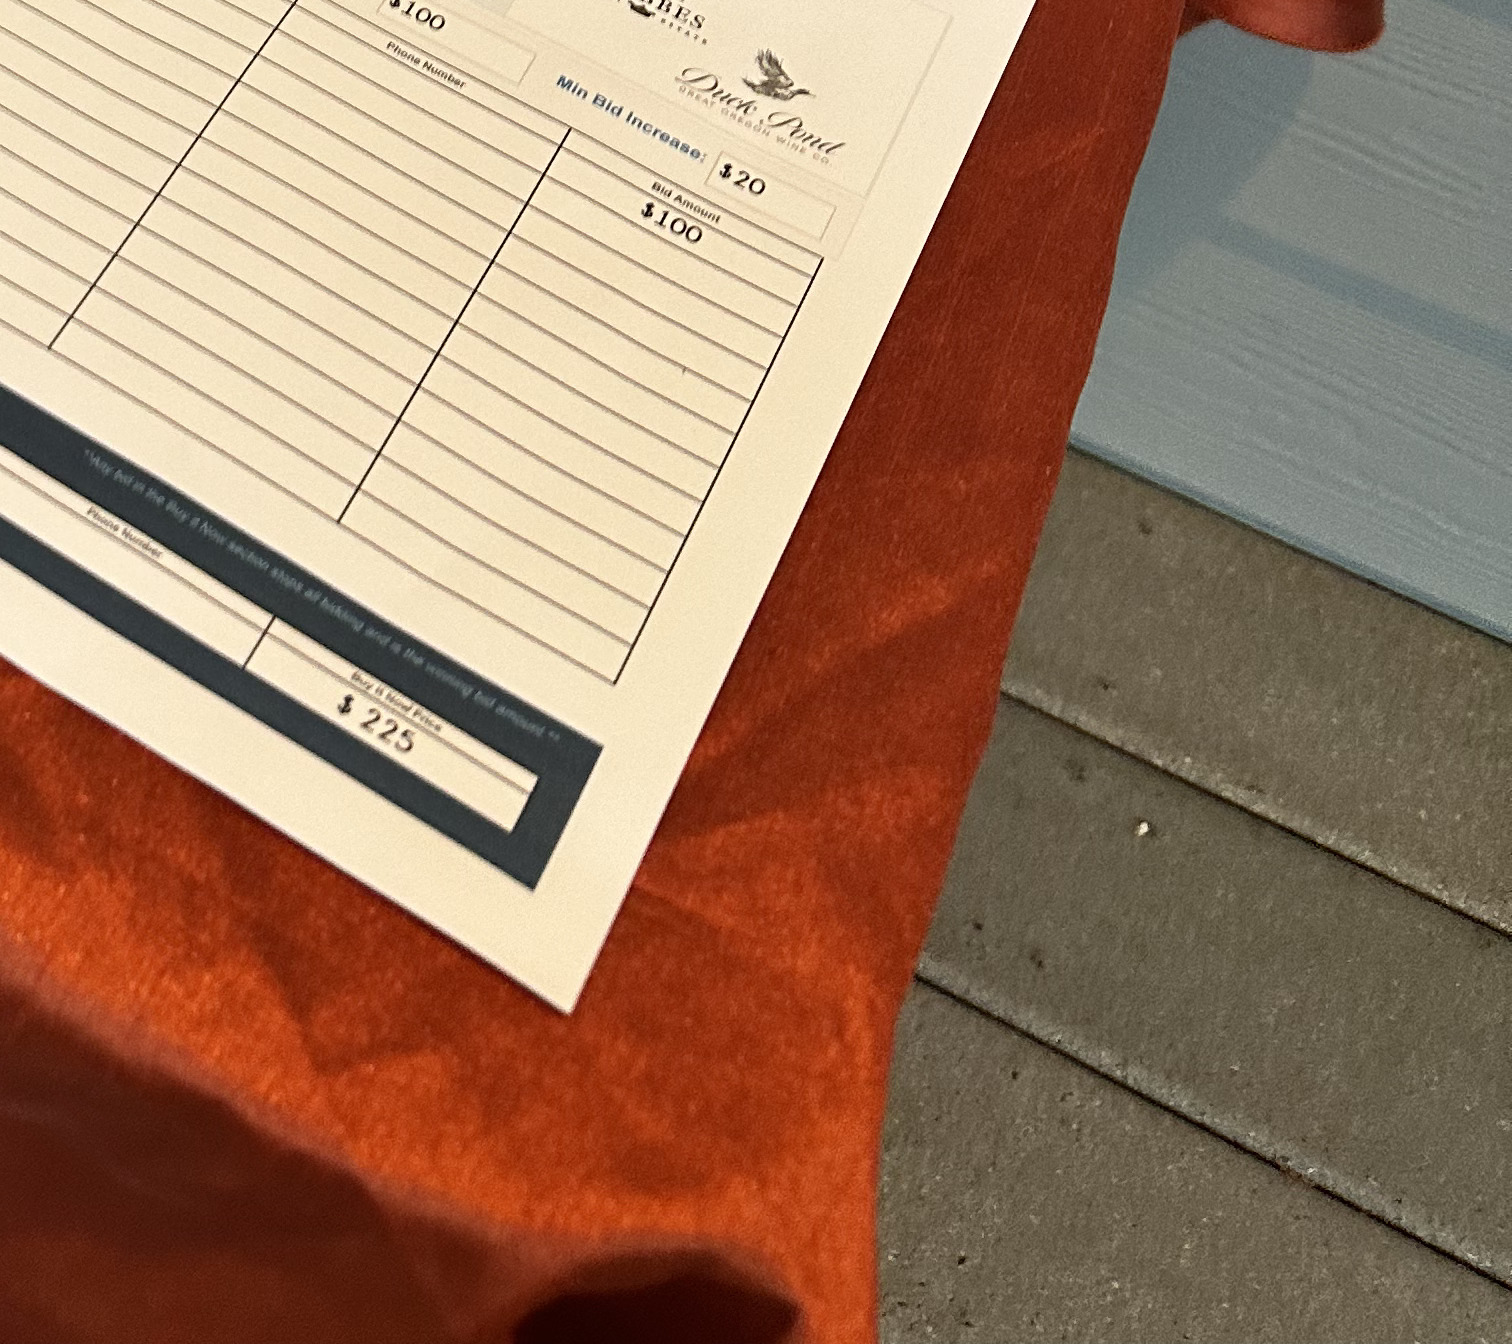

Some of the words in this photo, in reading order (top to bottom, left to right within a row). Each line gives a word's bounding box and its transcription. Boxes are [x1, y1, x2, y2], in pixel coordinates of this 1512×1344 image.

[681, 67, 760, 116] Duck
[759, 111, 845, 155] Pond
[719, 163, 766, 195] $20
[641, 202, 703, 243] $100
[337, 694, 355, 715] $
[361, 708, 414, 753] 225
